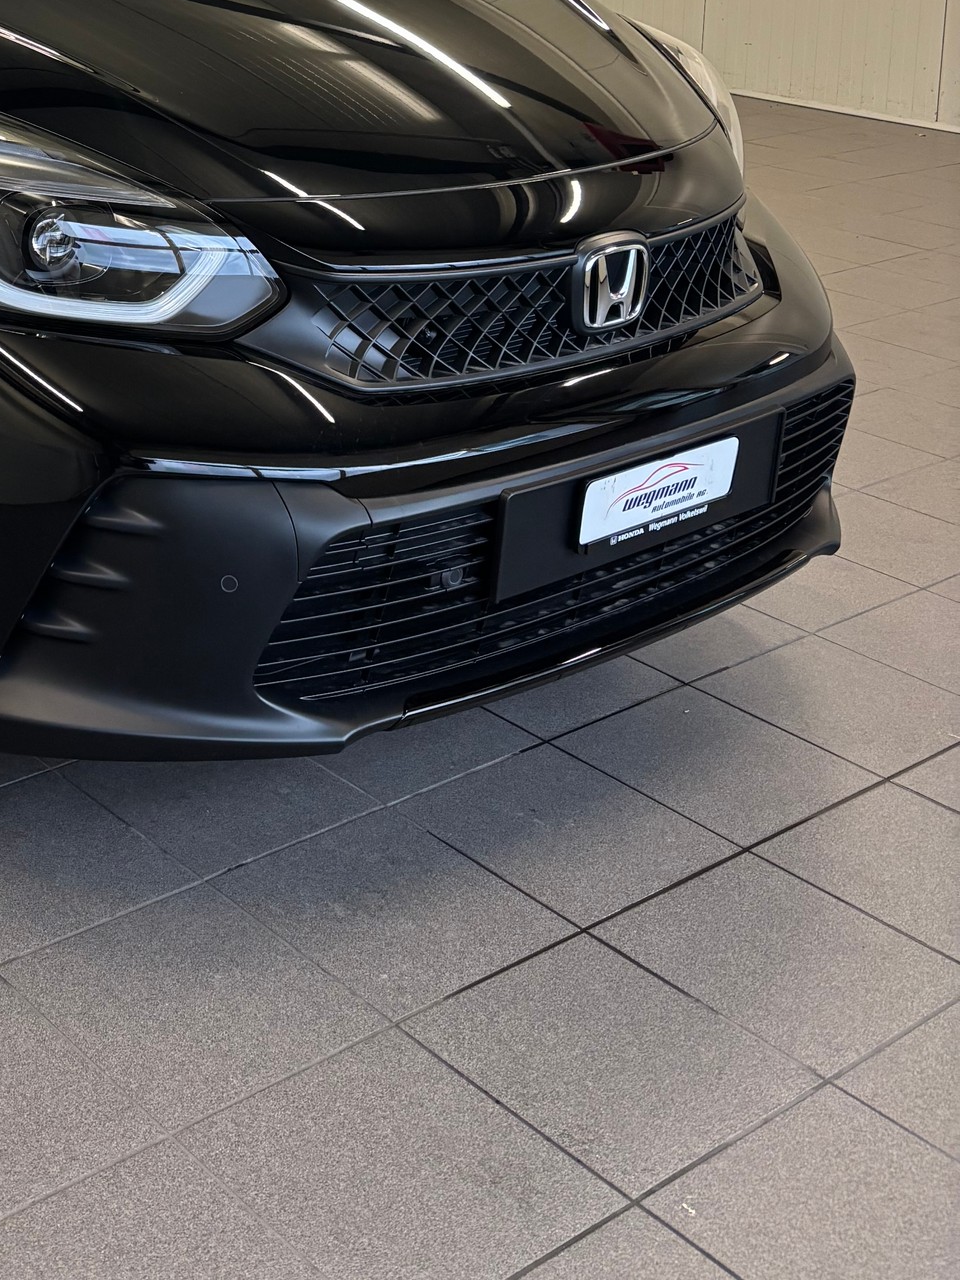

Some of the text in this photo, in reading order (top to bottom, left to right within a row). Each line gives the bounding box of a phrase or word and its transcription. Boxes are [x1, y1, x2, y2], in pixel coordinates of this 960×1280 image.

[622, 476, 698, 513] wegmann
[618, 528, 645, 542] HONDA
[648, 516, 678, 532] Wegmann
